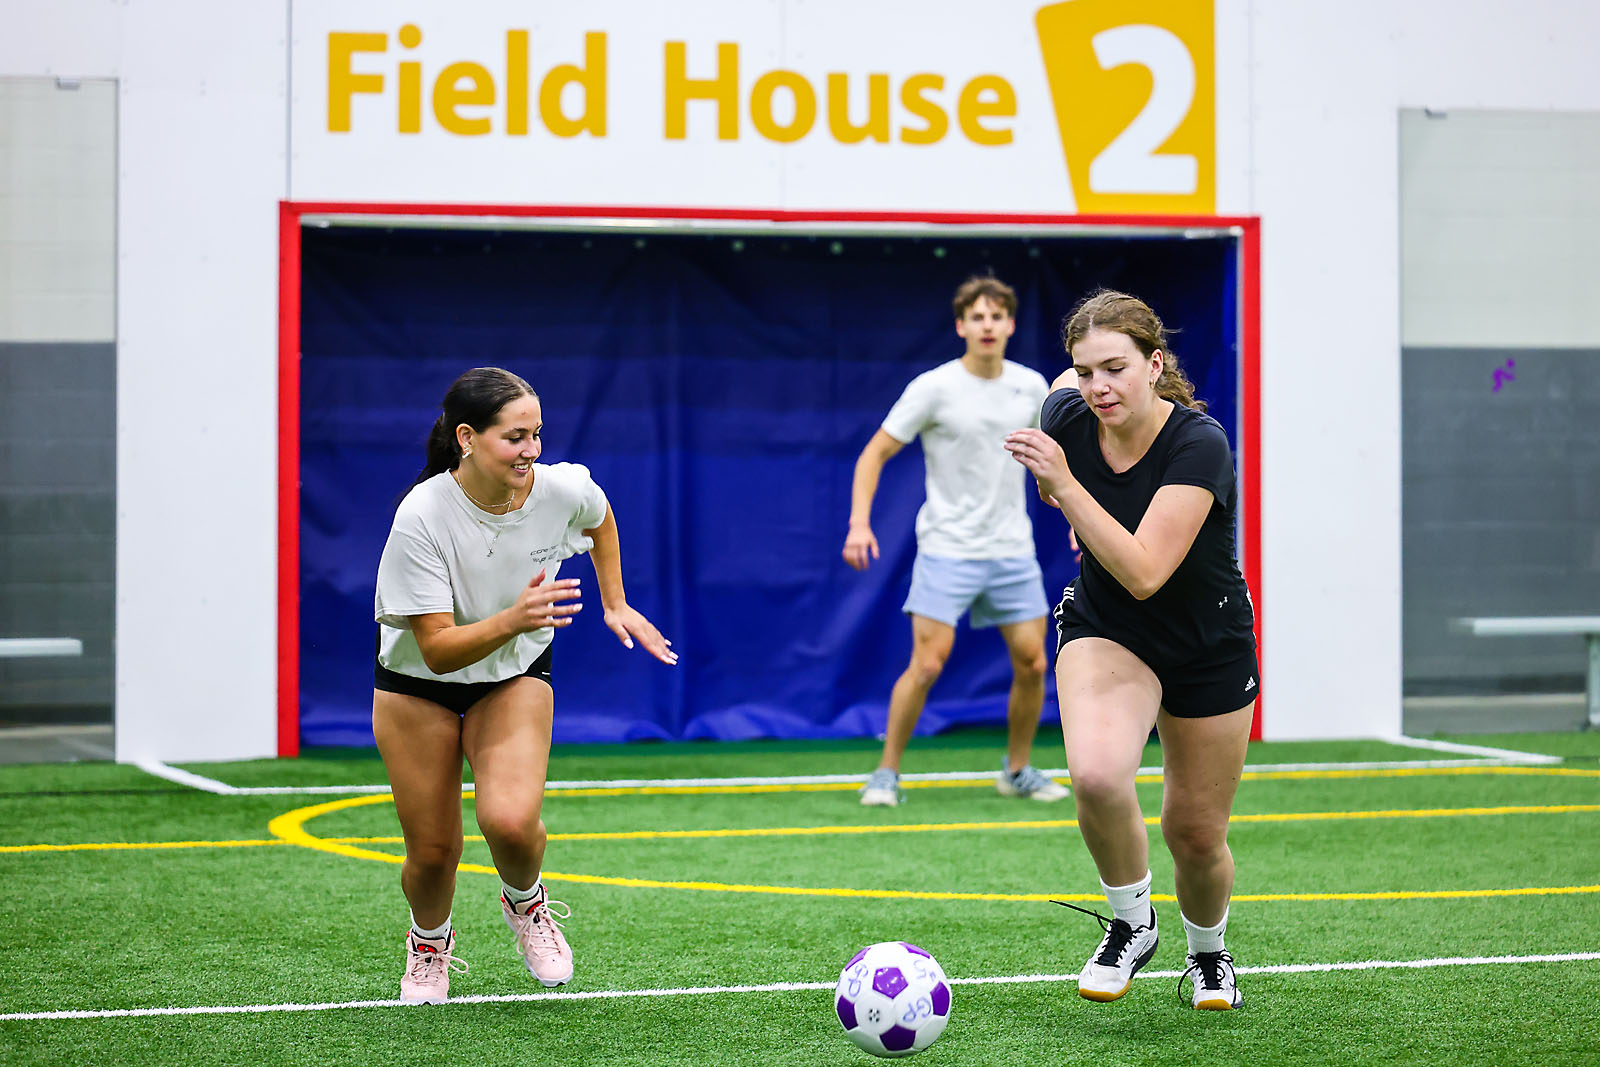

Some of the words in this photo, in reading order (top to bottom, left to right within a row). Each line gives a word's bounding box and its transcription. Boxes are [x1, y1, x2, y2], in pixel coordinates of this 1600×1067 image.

[327, 24, 607, 139] Field
[664, 41, 1017, 147] House
[1088, 24, 1198, 195] 2
[903, 997, 931, 1022] GP
